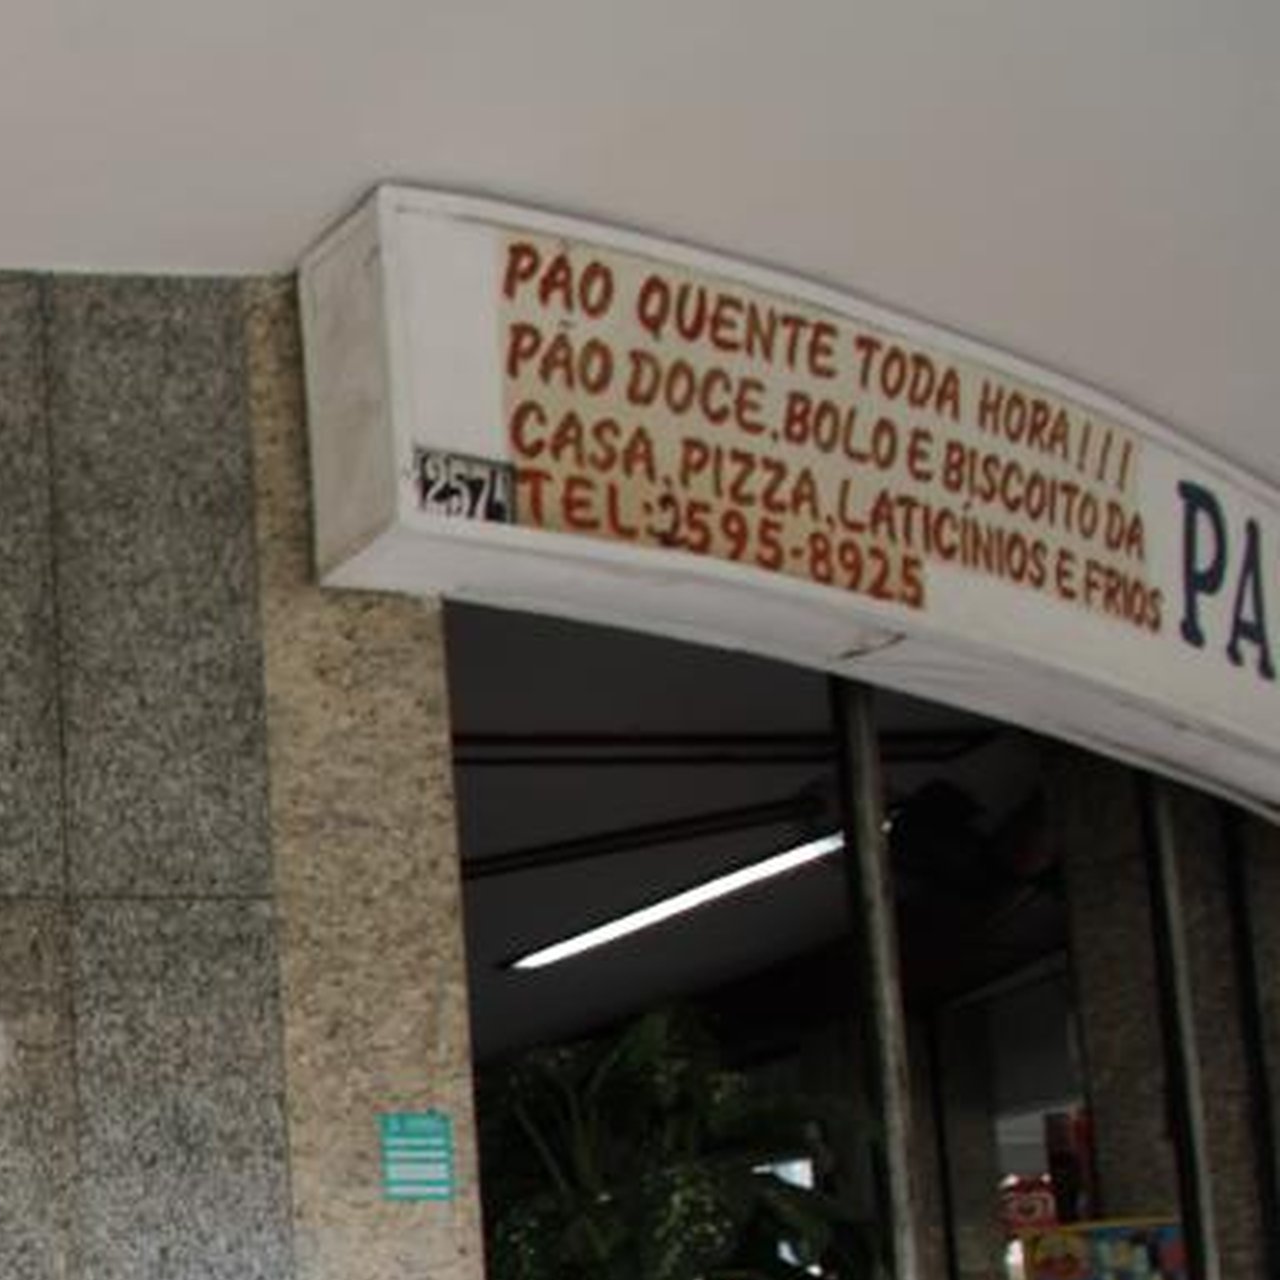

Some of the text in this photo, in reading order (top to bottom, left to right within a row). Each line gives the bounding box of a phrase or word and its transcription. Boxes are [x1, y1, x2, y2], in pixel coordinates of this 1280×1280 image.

[637, 275, 838, 379] QUENTE
[853, 335, 961, 422] TODA
[420, 451, 496, 521] 257
[506, 319, 613, 394] PÃO
[907, 427, 934, 482] E
[943, 439, 1099, 541] BISCOITO
[1104, 511, 1146, 563] DA
[1055, 551, 1079, 600] E
[1086, 560, 1163, 634] FRIOS
[1177, 480, 1277, 681] PA
